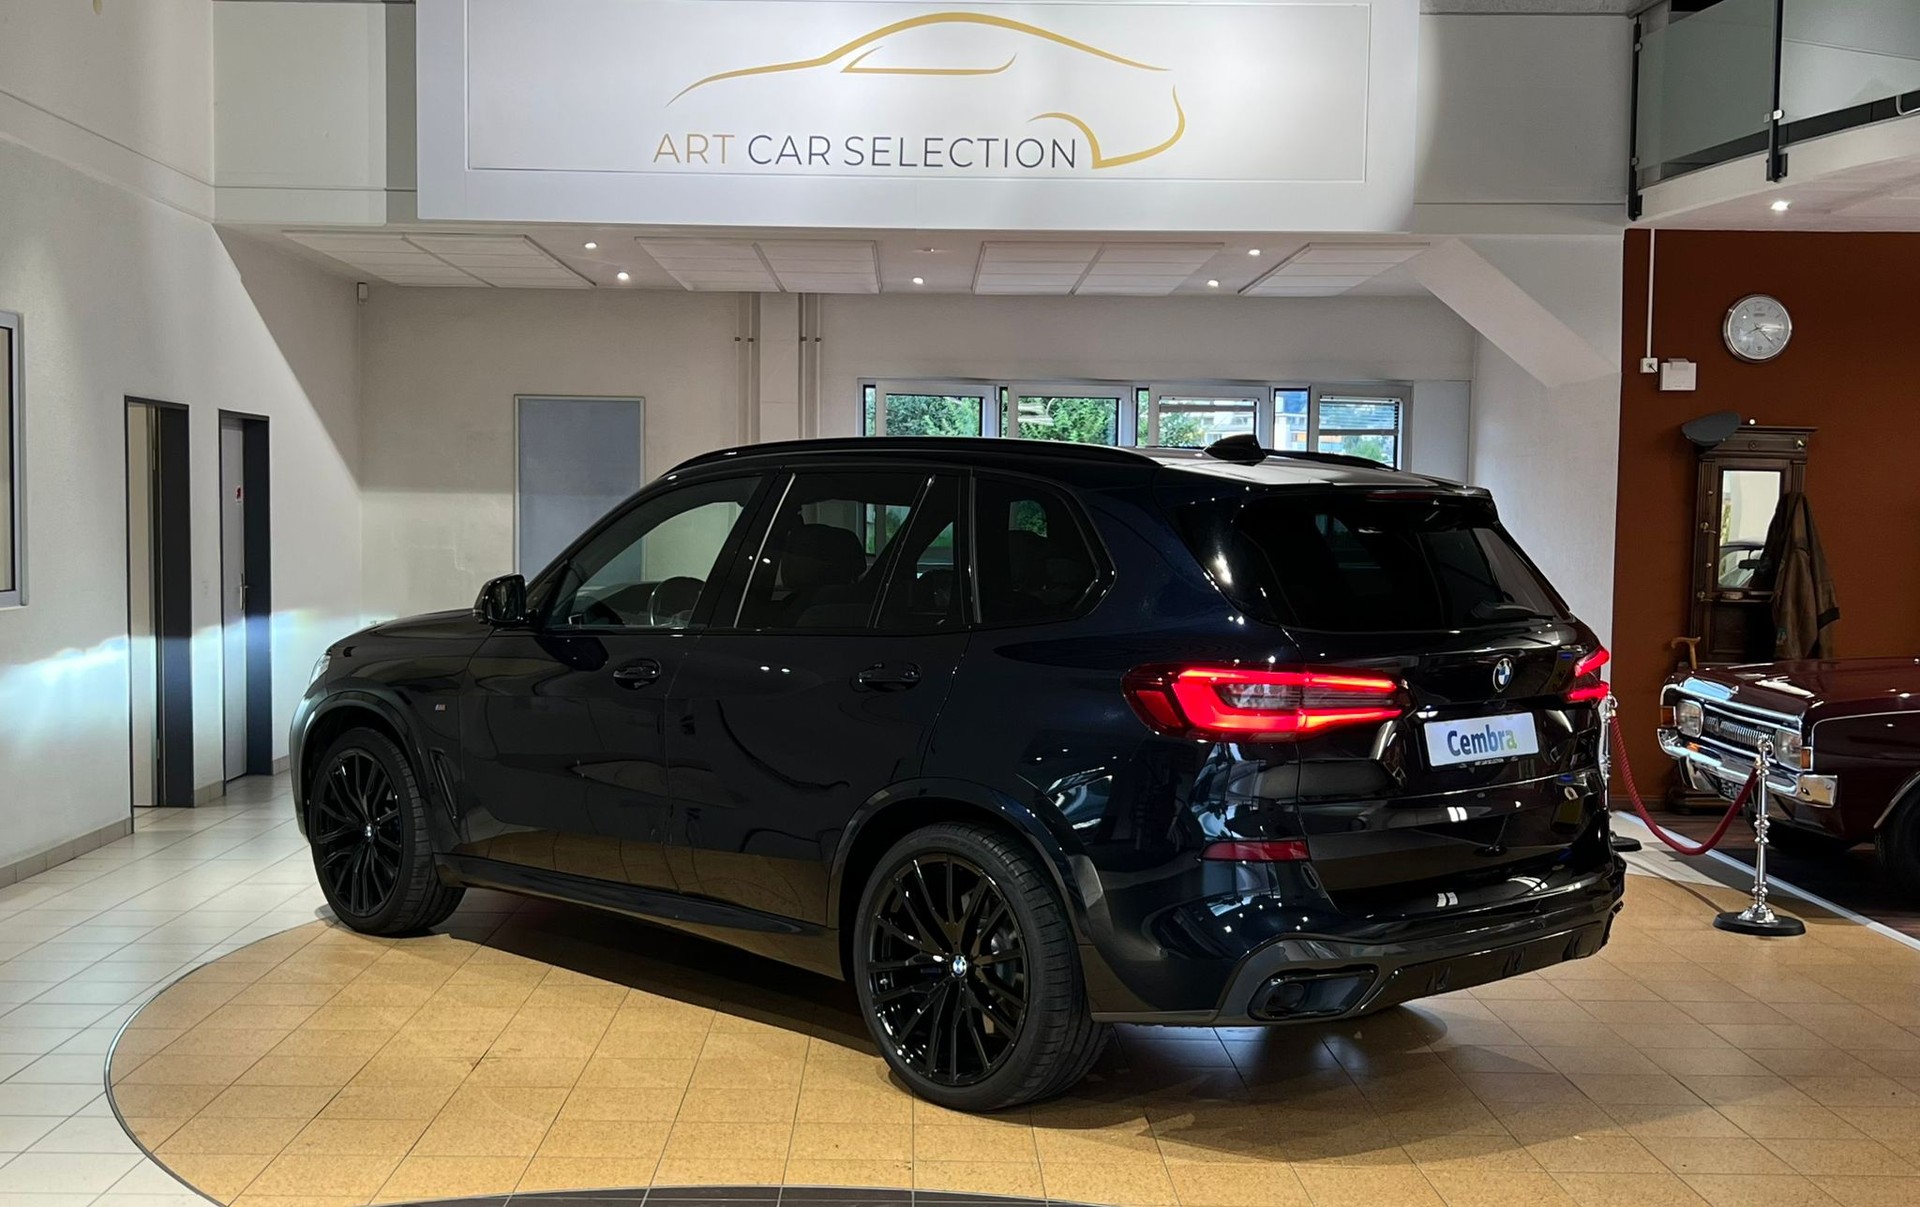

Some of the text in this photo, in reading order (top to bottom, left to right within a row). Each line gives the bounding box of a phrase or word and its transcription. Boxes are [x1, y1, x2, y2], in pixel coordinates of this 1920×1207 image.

[653, 133, 1076, 169] ART CAR SELECTION
[1446, 724, 1518, 757] Cembra
